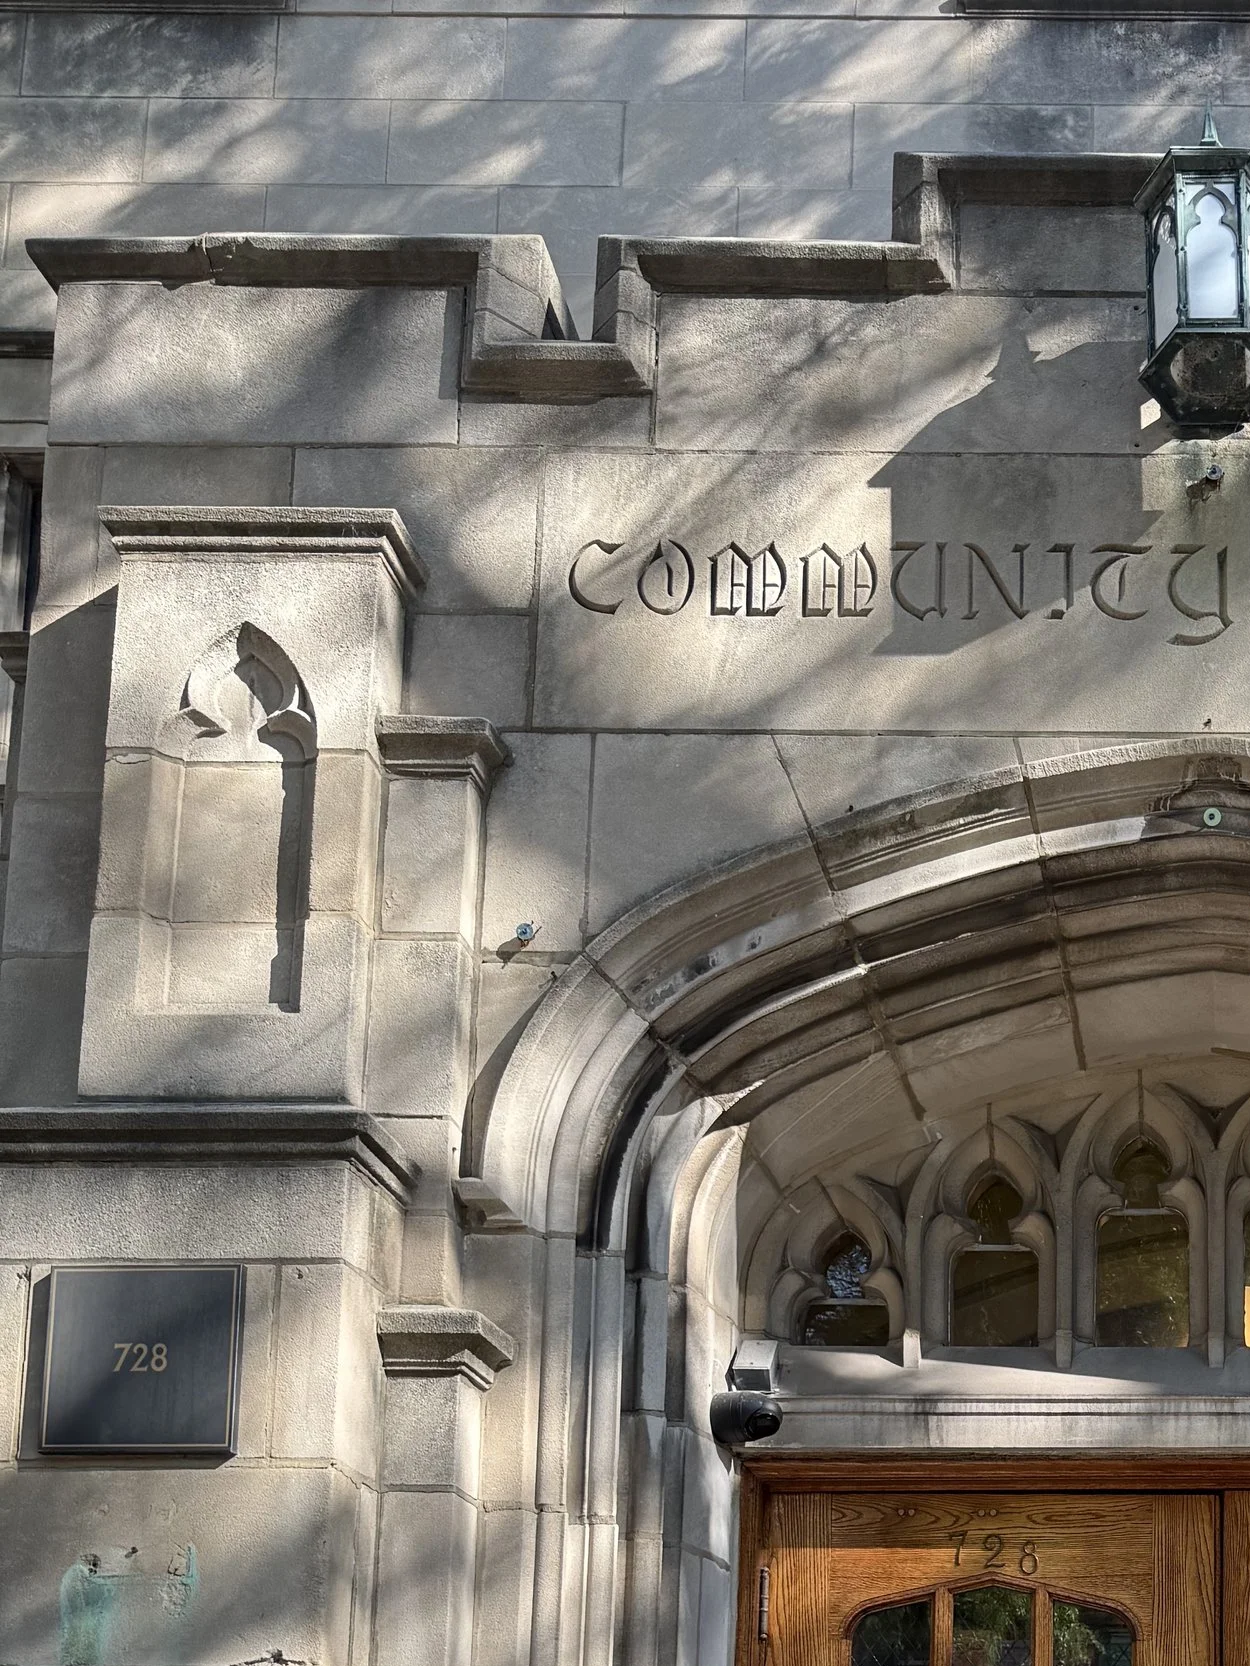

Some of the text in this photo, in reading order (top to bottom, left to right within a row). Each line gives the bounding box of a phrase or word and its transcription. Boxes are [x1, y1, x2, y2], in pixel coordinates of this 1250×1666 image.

[567, 537, 1234, 646] COMMUNITY
[112, 1342, 168, 1373] 728
[949, 1530, 1039, 1575] 728
